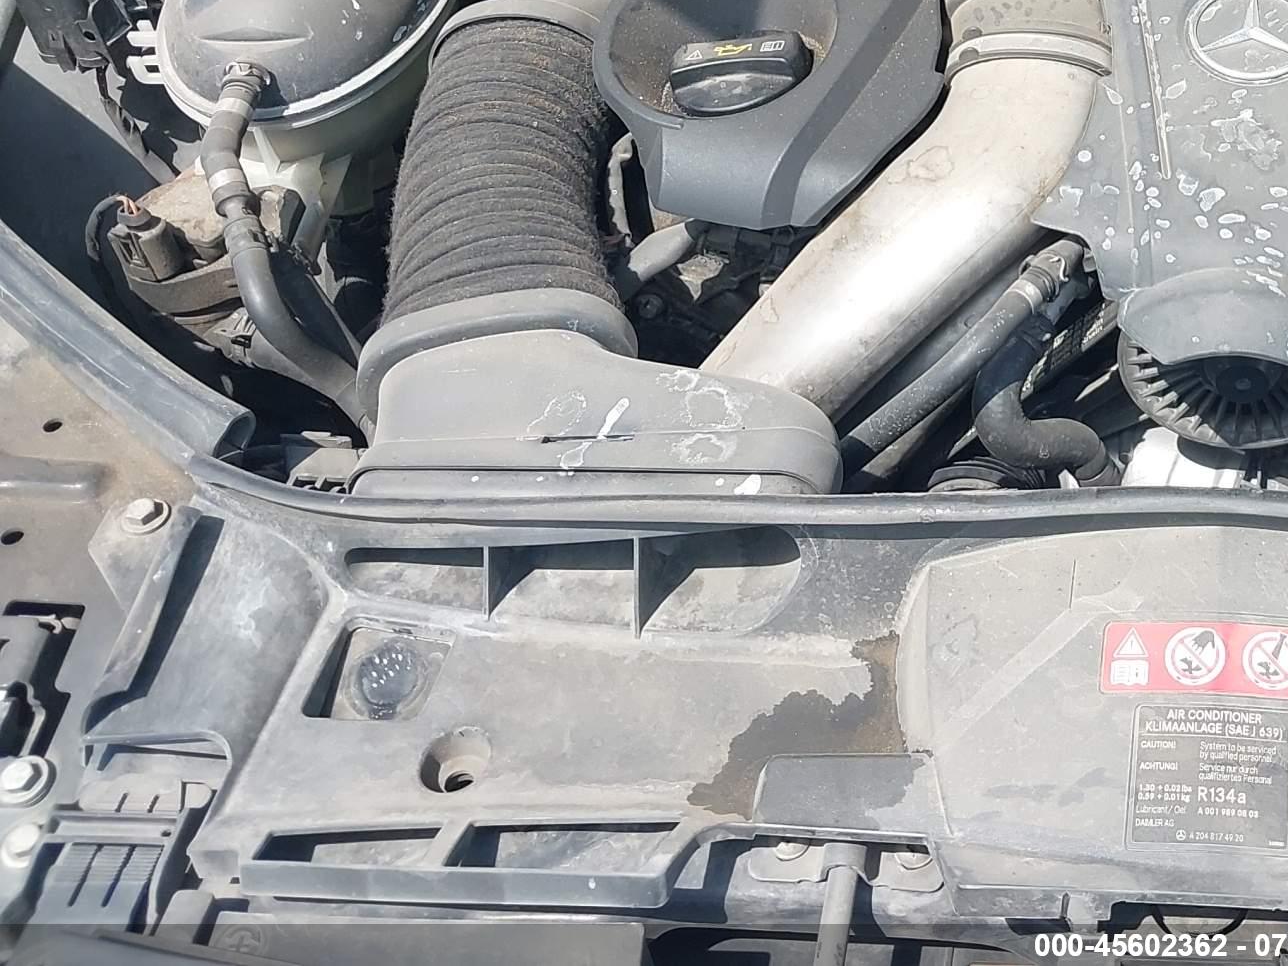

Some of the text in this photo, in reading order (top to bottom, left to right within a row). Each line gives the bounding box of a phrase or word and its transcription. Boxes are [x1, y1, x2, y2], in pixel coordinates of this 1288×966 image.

[1167, 709, 1262, 724] AIR CONDITIONER
[1145, 721, 1222, 734] KLIMAANLAGE
[1259, 728, 1283, 740] 639)
[1140, 740, 1176, 749] CAUTION!
[1200, 741, 1227, 751] System
[1237, 743, 1246, 752] be
[1247, 745, 1277, 755] serviced
[1199, 751, 1209, 761] by
[1139, 762, 1178, 771] ACHTUNG!
[1199, 763, 1226, 772] Service
[1197, 786, 1247, 804] R134a
[1197, 807, 1203, 815] A
